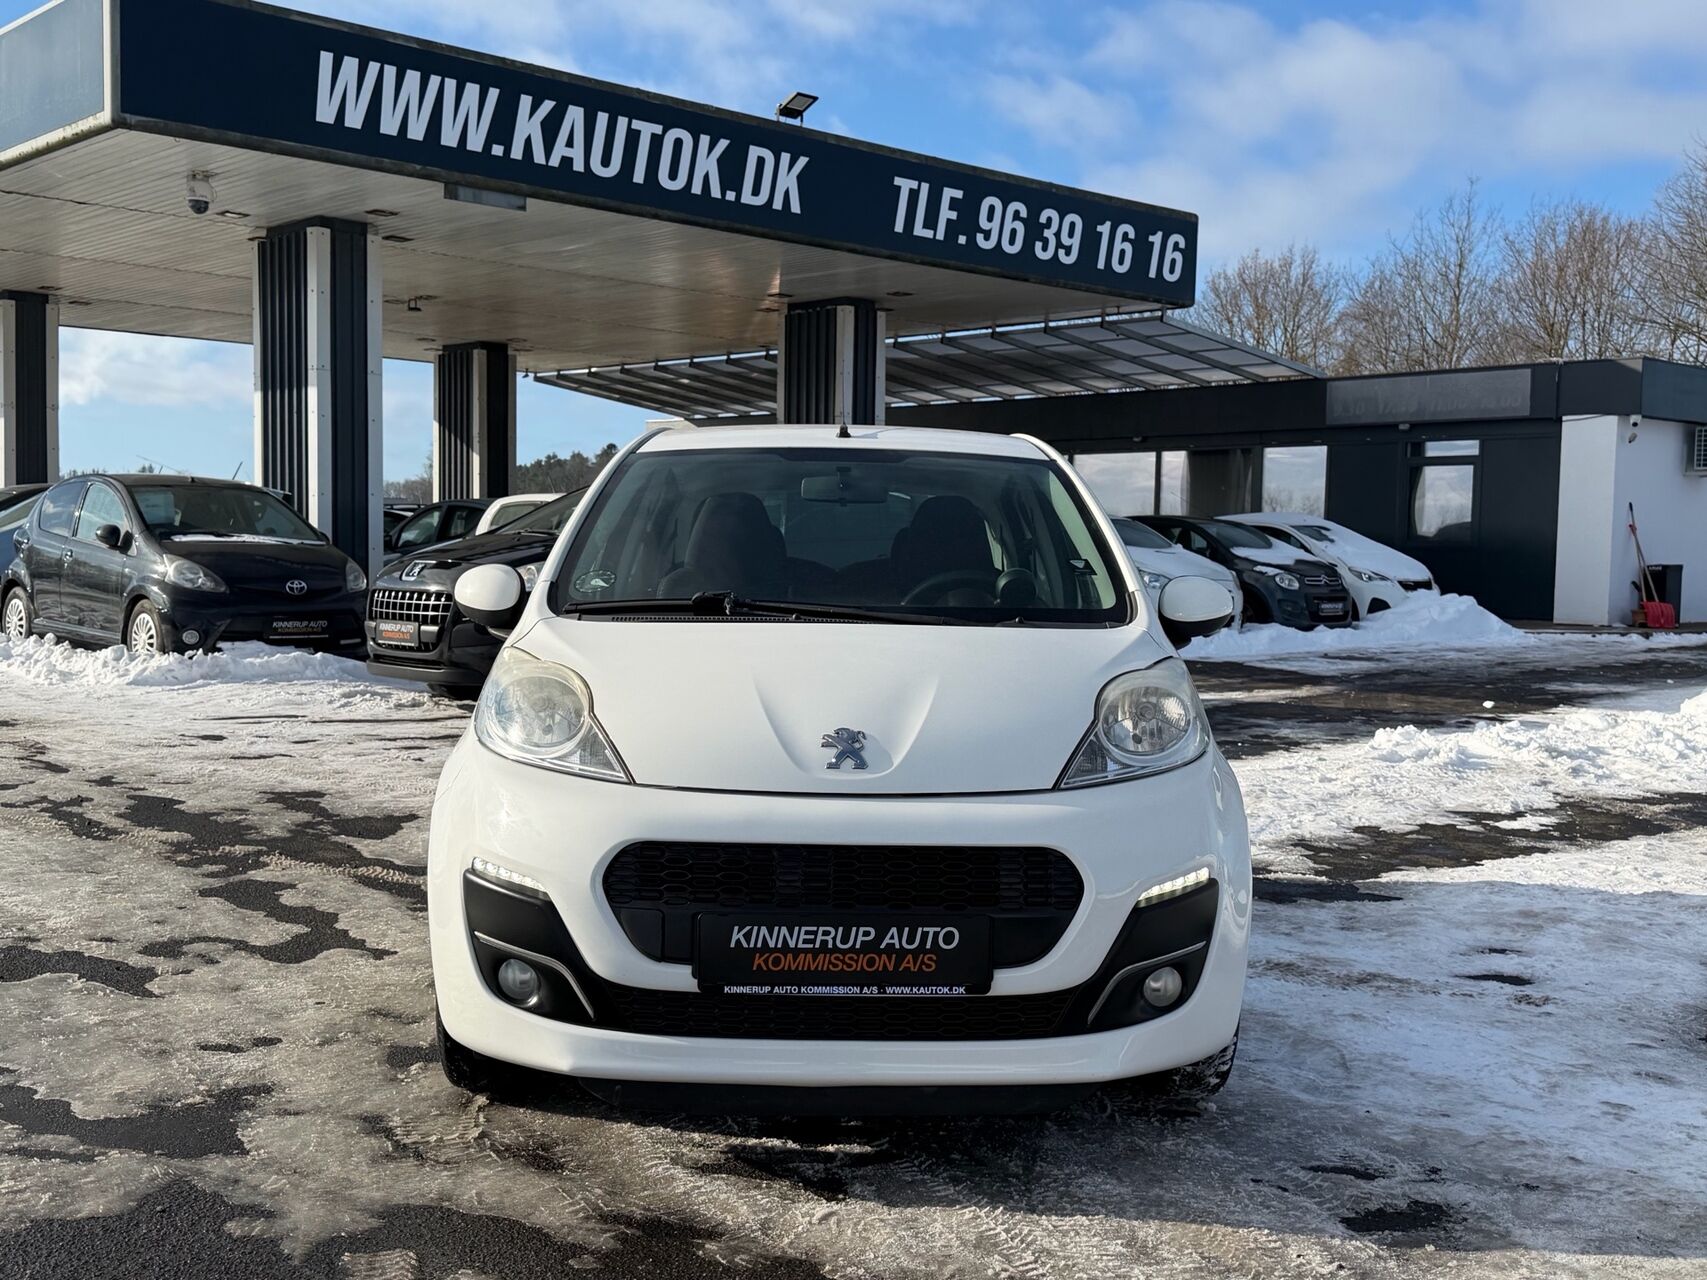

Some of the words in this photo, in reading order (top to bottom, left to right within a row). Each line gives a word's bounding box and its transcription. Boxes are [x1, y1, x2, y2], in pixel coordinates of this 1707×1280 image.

[315, 50, 810, 214] WWW.KAUTOK.DK
[893, 176, 967, 245] TLF.
[975, 196, 1028, 254] 96
[1034, 208, 1083, 265] 39
[1096, 220, 1136, 274] 16
[1148, 230, 1186, 283] 16
[309, 620, 328, 628] AUTO
[729, 925, 875, 949] KINNERUP
[880, 926, 960, 950] AUTO
[752, 952, 896, 972] KOMMISSION
[898, 953, 937, 972] A/S
[724, 985, 771, 994] KINNERUP
[772, 985, 799, 994] AUTO
[800, 985, 860, 995] KOMMISSION
[861, 986, 879, 995] A/S
[885, 986, 966, 995] WWW.KAUTOK.DK
